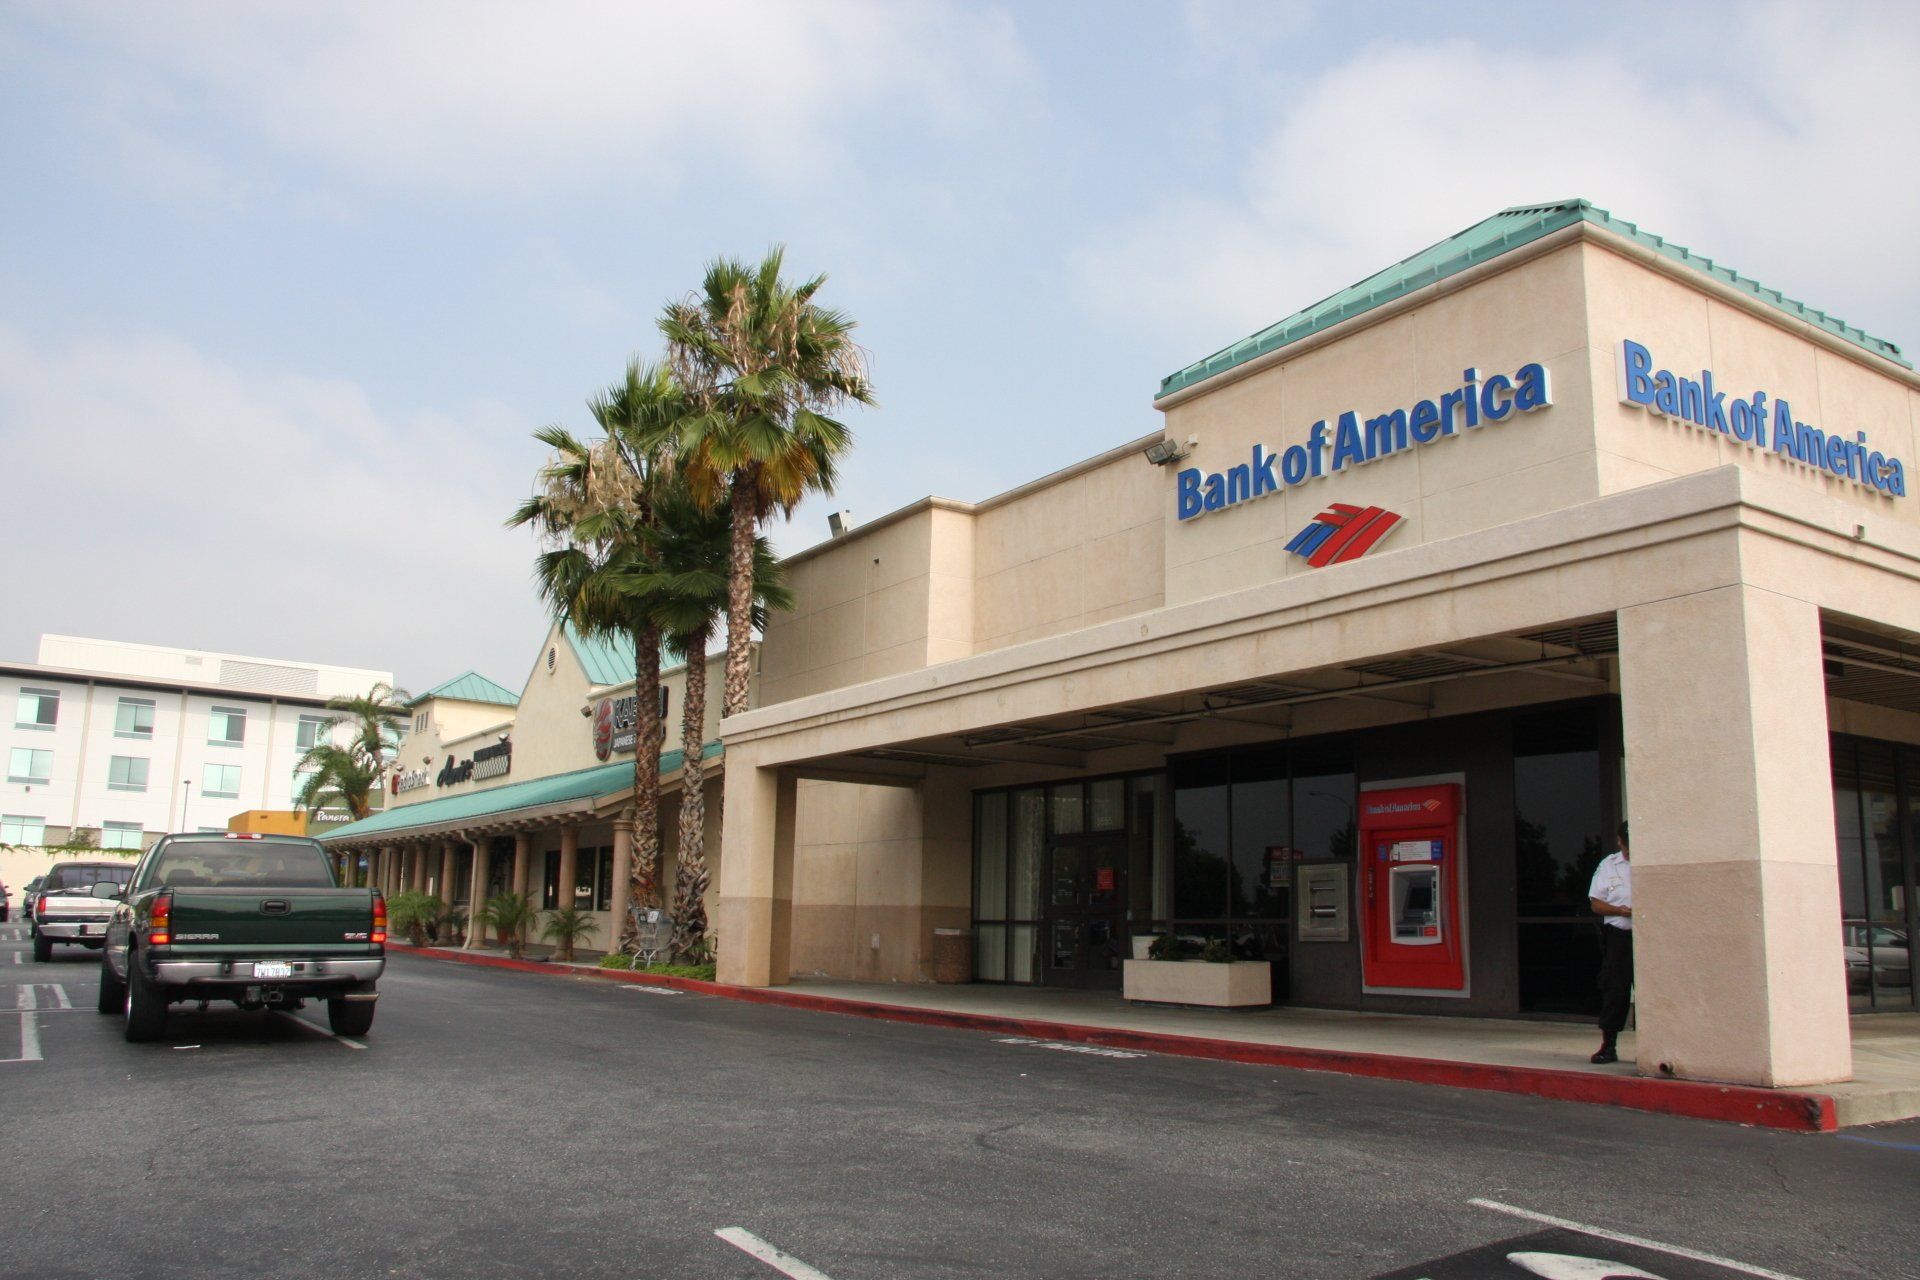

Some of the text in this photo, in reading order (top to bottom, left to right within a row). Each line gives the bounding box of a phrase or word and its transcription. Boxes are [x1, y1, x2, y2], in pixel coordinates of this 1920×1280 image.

[1177, 362, 1554, 522] Bank of America
[1624, 339, 1906, 498] Bank of America
[316, 810, 350, 823] Panera
